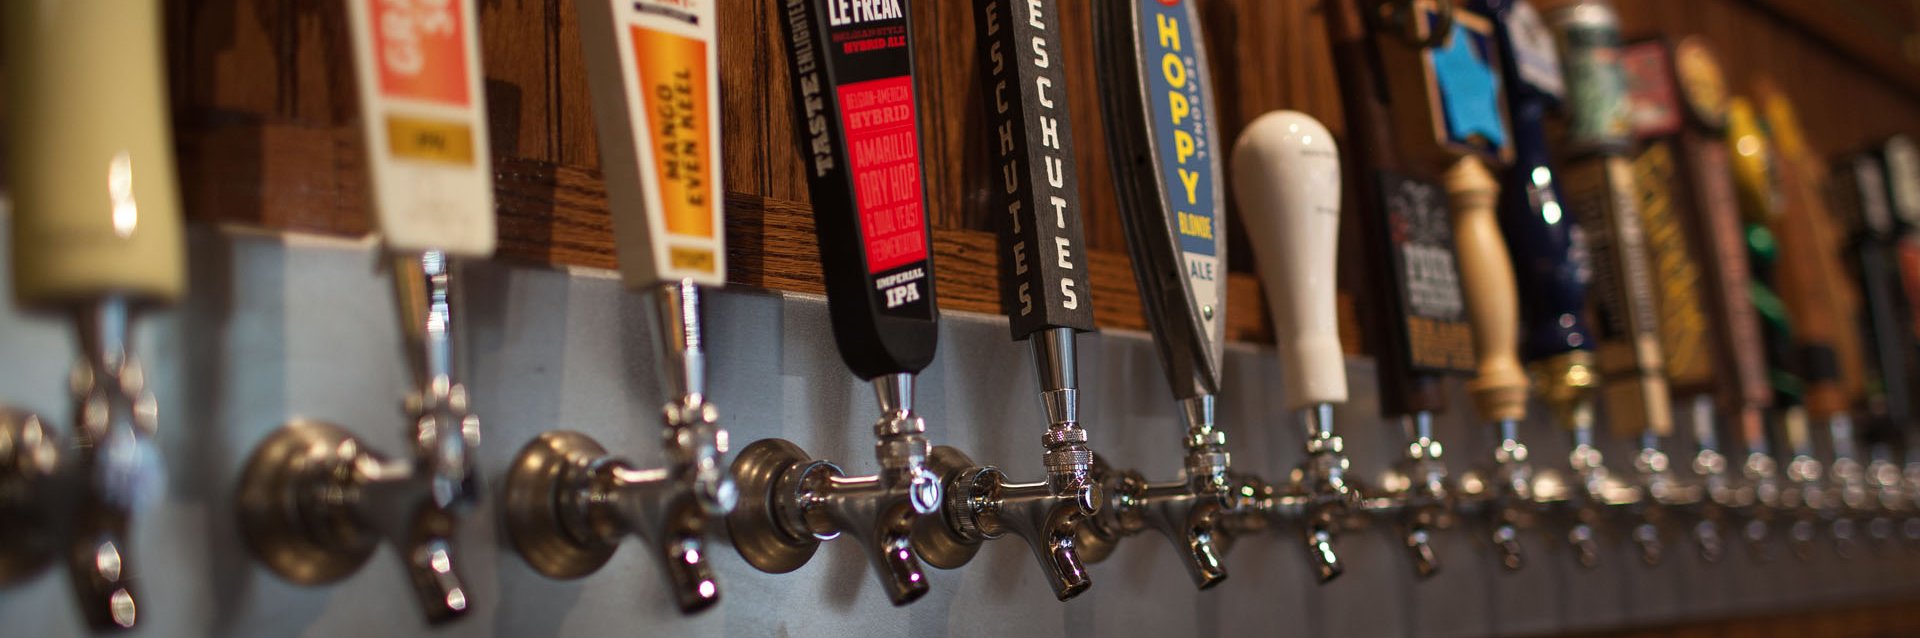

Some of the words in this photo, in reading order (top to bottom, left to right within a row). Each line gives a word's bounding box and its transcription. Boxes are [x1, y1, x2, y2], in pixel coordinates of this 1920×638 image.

[828, 0, 851, 26] LE
[852, 0, 903, 23] FREAK
[887, 35, 906, 48] ALE
[674, 69, 695, 130] KEEL
[1156, 13, 1200, 204] HOPPY
[1184, 56, 1206, 160] SEASONAL
[656, 83, 680, 181] MANGO
[801, 72, 834, 177] TASTE
[849, 104, 910, 129] HYBRID
[855, 131, 914, 168] AMARILLO
[684, 140, 704, 206] EVEN
[859, 167, 889, 209] DRY
[889, 162, 916, 202] HOP
[895, 202, 919, 230] YEAST
[1178, 211, 1213, 239] BLONDE
[876, 268, 924, 290] IMPERIAL
[1191, 260, 1213, 280] ALE
[885, 282, 920, 308] IPA
